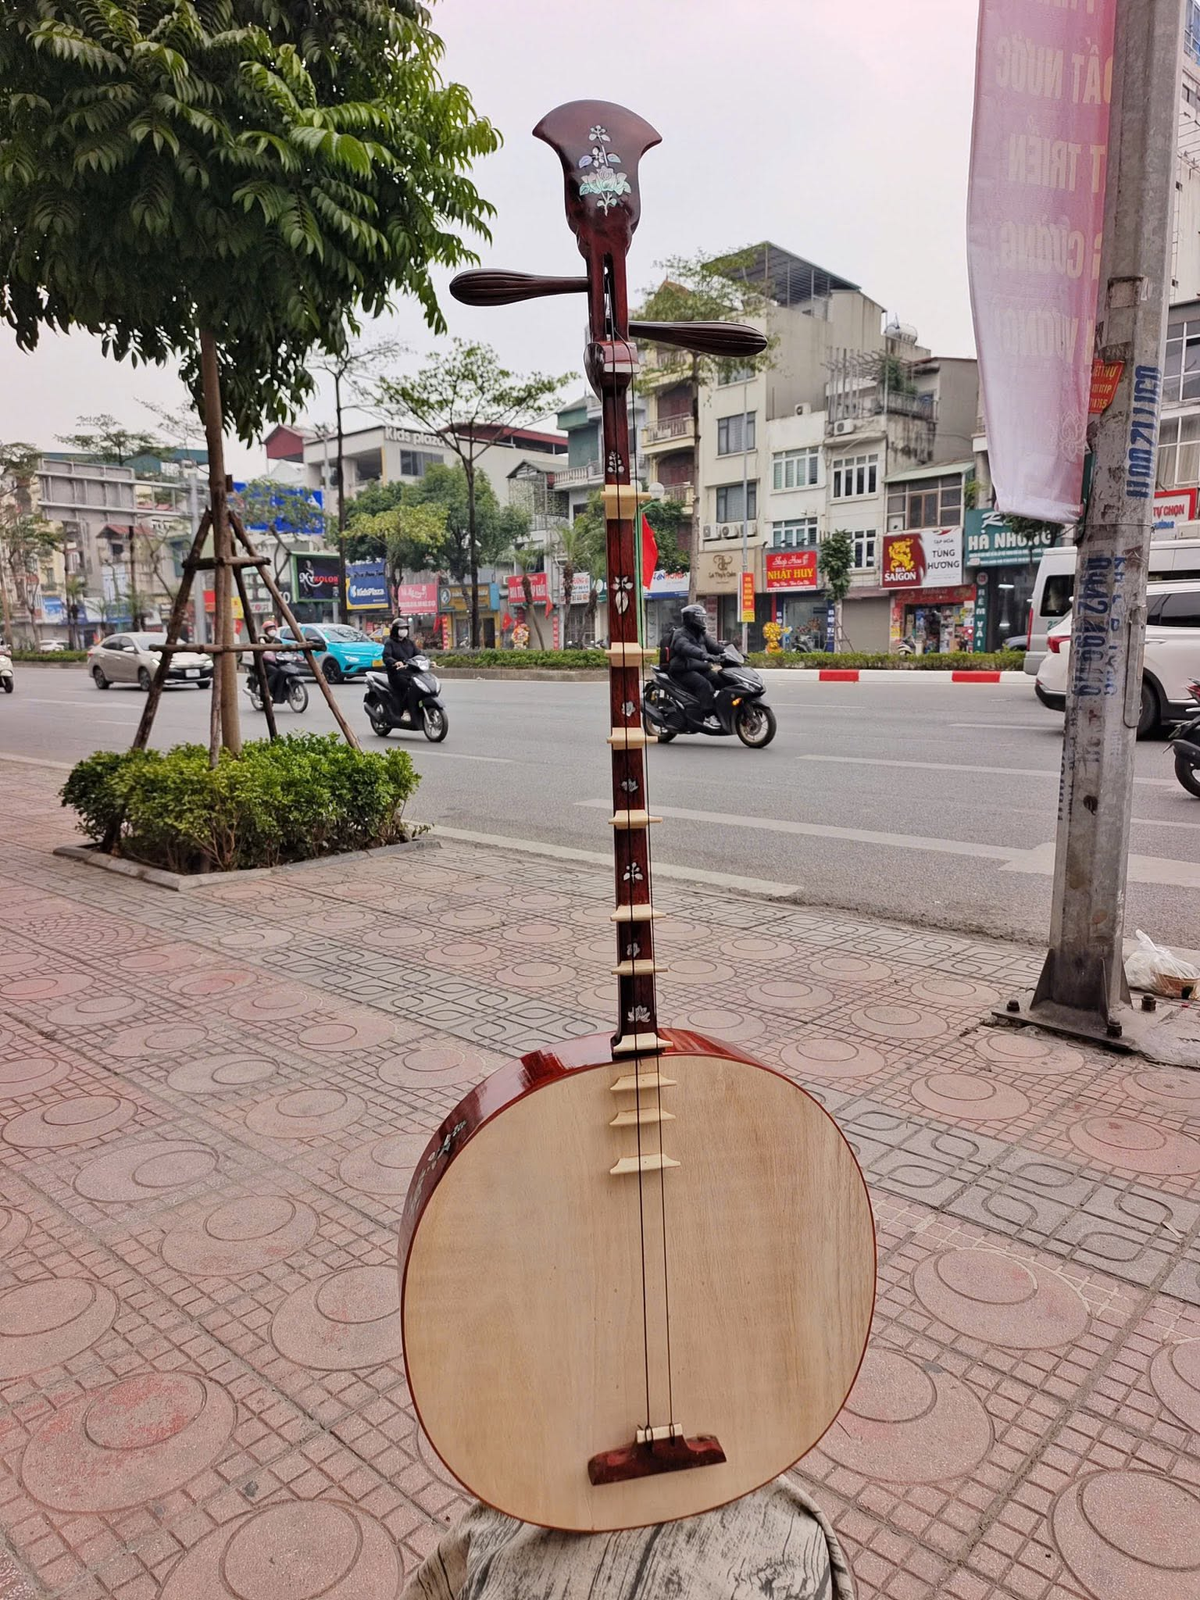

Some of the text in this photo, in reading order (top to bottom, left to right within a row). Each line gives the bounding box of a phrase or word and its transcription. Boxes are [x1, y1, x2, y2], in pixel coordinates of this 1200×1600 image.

[968, 530, 989, 551] HÀ
[932, 547, 955, 558] TÙNG
[927, 560, 960, 570] HƯƠNG
[767, 568, 813, 580] NHẬT HUY
[885, 572, 916, 581] SAIGON
